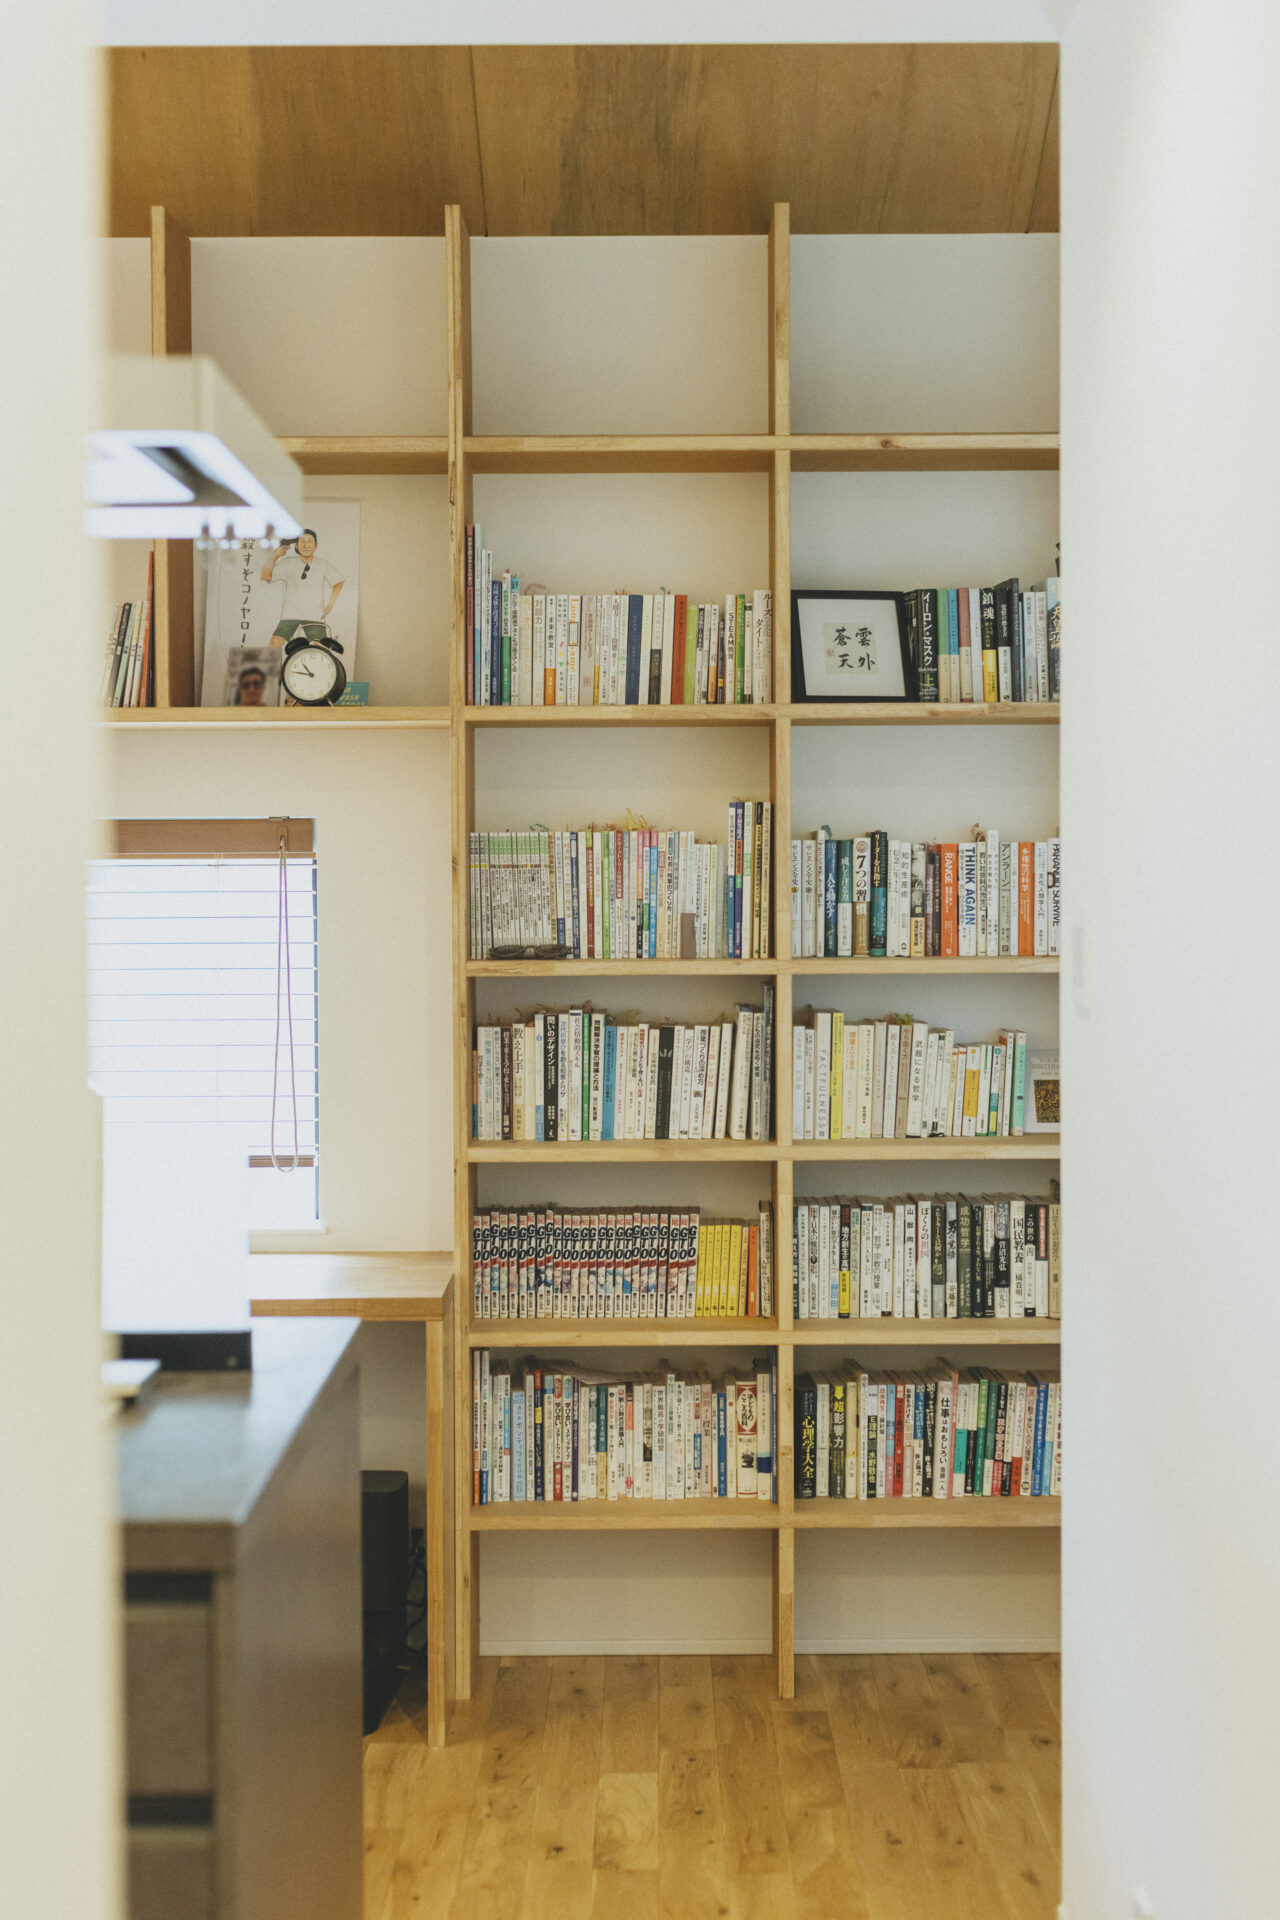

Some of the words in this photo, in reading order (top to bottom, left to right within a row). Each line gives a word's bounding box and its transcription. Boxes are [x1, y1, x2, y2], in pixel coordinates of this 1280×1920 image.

[240, 538, 255, 648] 殺すぞコノヤロー
[923, 592, 933, 666] イーロン・マスク
[923, 674, 935, 687] 上
[944, 852, 953, 884] RANGE
[965, 847, 976, 885] THINK
[1001, 843, 1010, 888] アンラーン
[826, 873, 837, 918] 人を動かす
[856, 855, 869, 915] 7つの習慣
[965, 888, 976, 926] AGAIN
[1052, 890, 1060, 926] SURVIVE
[513, 1027, 524, 1074] 教え上手
[546, 1016, 556, 1065] 問いのデザイン
[593, 1020, 601, 1091] 問題解決学習の理論と方法
[911, 1040, 923, 1102] 武器になる哲学
[818, 1049, 828, 1128] FACTFULNESS
[490, 1224, 499, 1256] GTO
[499, 1227, 508, 1259] GTO
[508, 1226, 517, 1258] GTO
[527, 1224, 535, 1256] GTO
[536, 1226, 545, 1258] GTO
[545, 1222, 553, 1254] GTO
[554, 1227, 562, 1259] GTO
[563, 1227, 572, 1259] GTO
[580, 1227, 589, 1259] GTO
[589, 1227, 597, 1259] GTO
[598, 1227, 607, 1259] GTO
[616, 1227, 624, 1259] GTO
[632, 1225, 641, 1257] GTO
[641, 1227, 650, 1259] GTO
[649, 1226, 658, 1258] GTO
[659, 1226, 668, 1258] GTO
[687, 1226, 697, 1258] GTO
[921, 1208, 930, 1258] ぼくらの祖国
[960, 1206, 970, 1248] 成功哲学
[473, 1228, 481, 1260] GTO
[481, 1228, 490, 1260] GTO
[519, 1227, 527, 1260] GTO
[571, 1228, 580, 1260] GTO
[606, 1227, 615, 1260] GTO
[624, 1227, 633, 1260] GTO
[669, 1228, 679, 1260] GTO
[679, 1227, 688, 1260] GTO
[657, 1390, 665, 1452] 世界最高の学級経営
[833, 1401, 845, 1448] 超影響力
[940, 1397, 950, 1464] 仕事はおもしろい
[802, 1416, 815, 1479] 心理学大全
